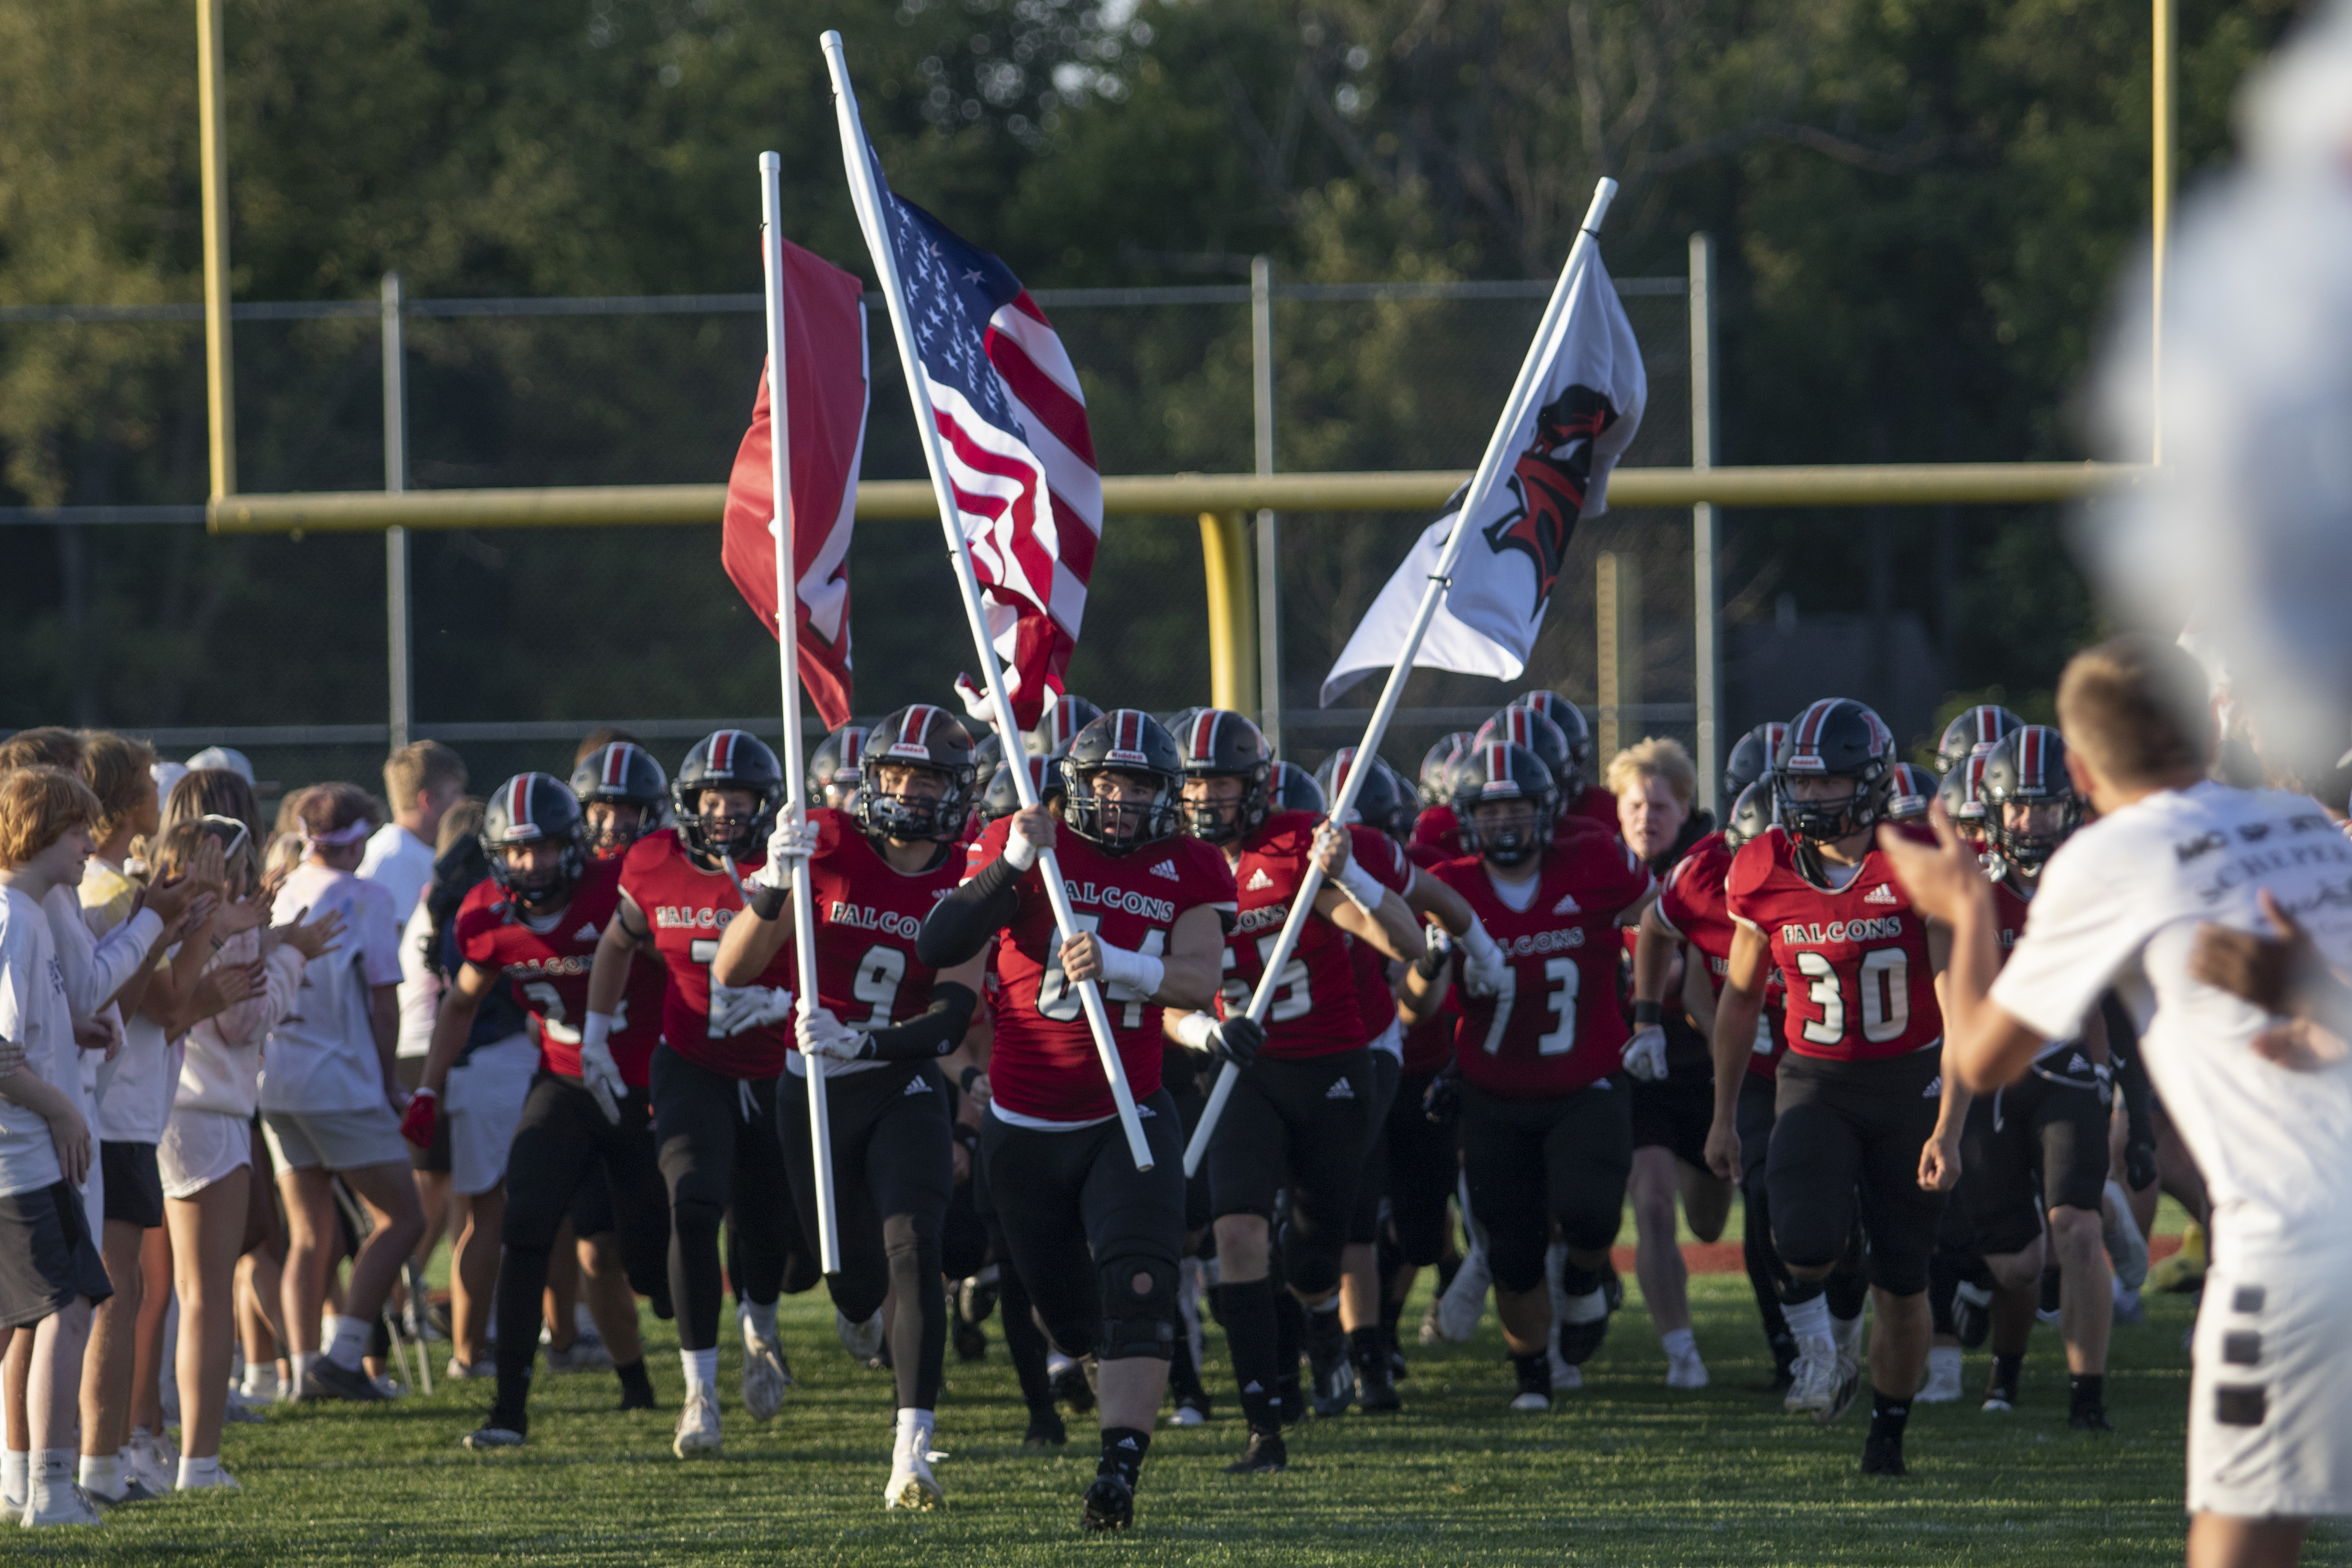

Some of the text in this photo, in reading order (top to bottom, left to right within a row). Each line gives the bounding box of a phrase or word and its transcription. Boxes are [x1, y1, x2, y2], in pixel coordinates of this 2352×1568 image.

[655, 905, 740, 933] FALCO
[829, 900, 921, 942] FALCO
[1061, 879, 1175, 923] ALCONS
[1782, 916, 1902, 946] FALCONS
[845, 944, 908, 1029] 9
[1796, 946, 1909, 1045] 30
